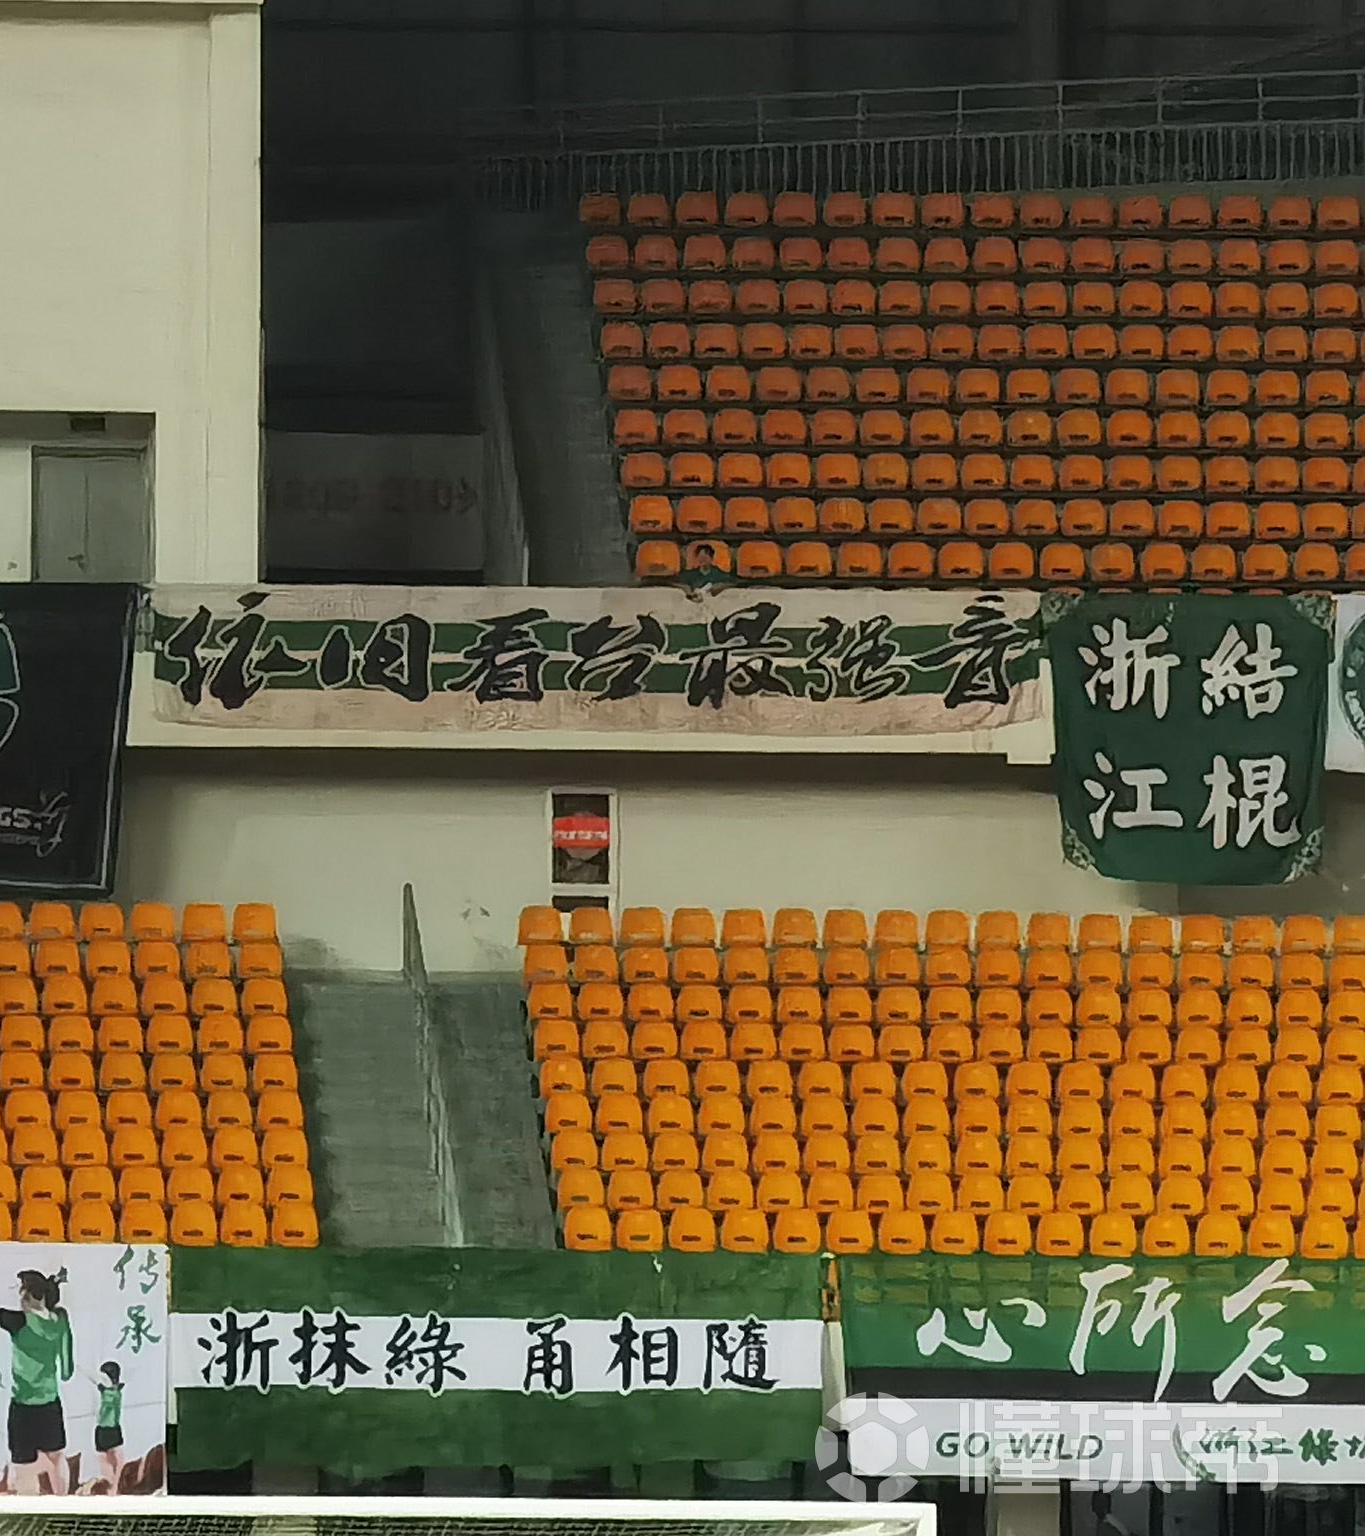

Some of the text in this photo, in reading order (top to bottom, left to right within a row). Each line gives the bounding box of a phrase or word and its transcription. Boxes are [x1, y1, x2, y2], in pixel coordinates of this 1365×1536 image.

[1077, 622, 1185, 842] 浙江
[114, 1244, 162, 1354] 传承
[196, 1312, 779, 1394] 浙抹綠 甬相隨
[917, 1258, 1327, 1402] 心所念
[937, 1432, 1103, 1461] GO WILD
